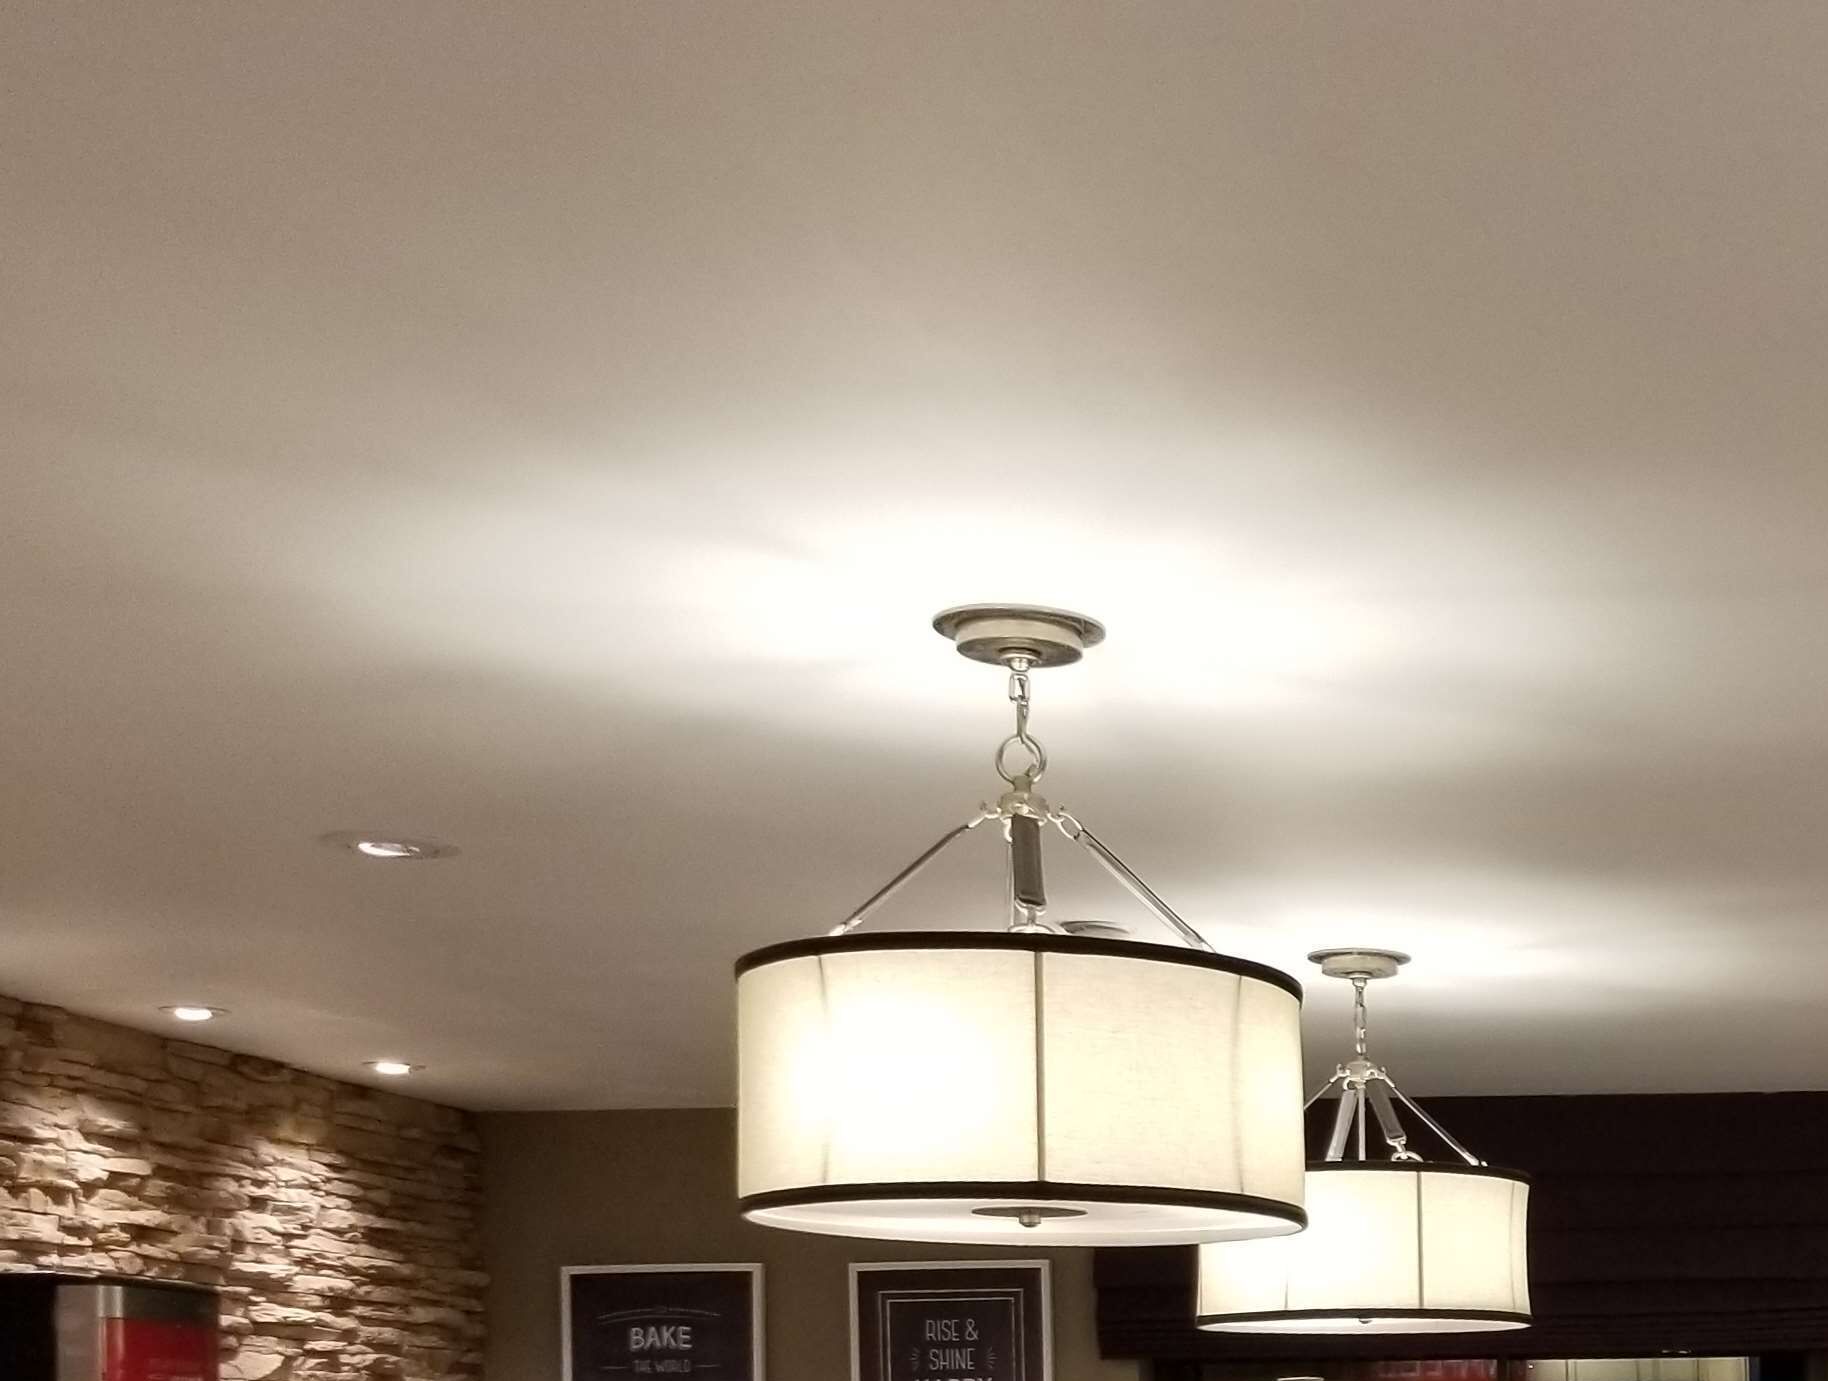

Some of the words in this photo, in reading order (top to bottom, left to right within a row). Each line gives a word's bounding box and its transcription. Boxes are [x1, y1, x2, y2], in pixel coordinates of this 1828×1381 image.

[630, 1326, 693, 1351] BAKE
[926, 1318, 960, 1341] RISE
[965, 1318, 979, 1341] &
[929, 1347, 976, 1371] SHINE
